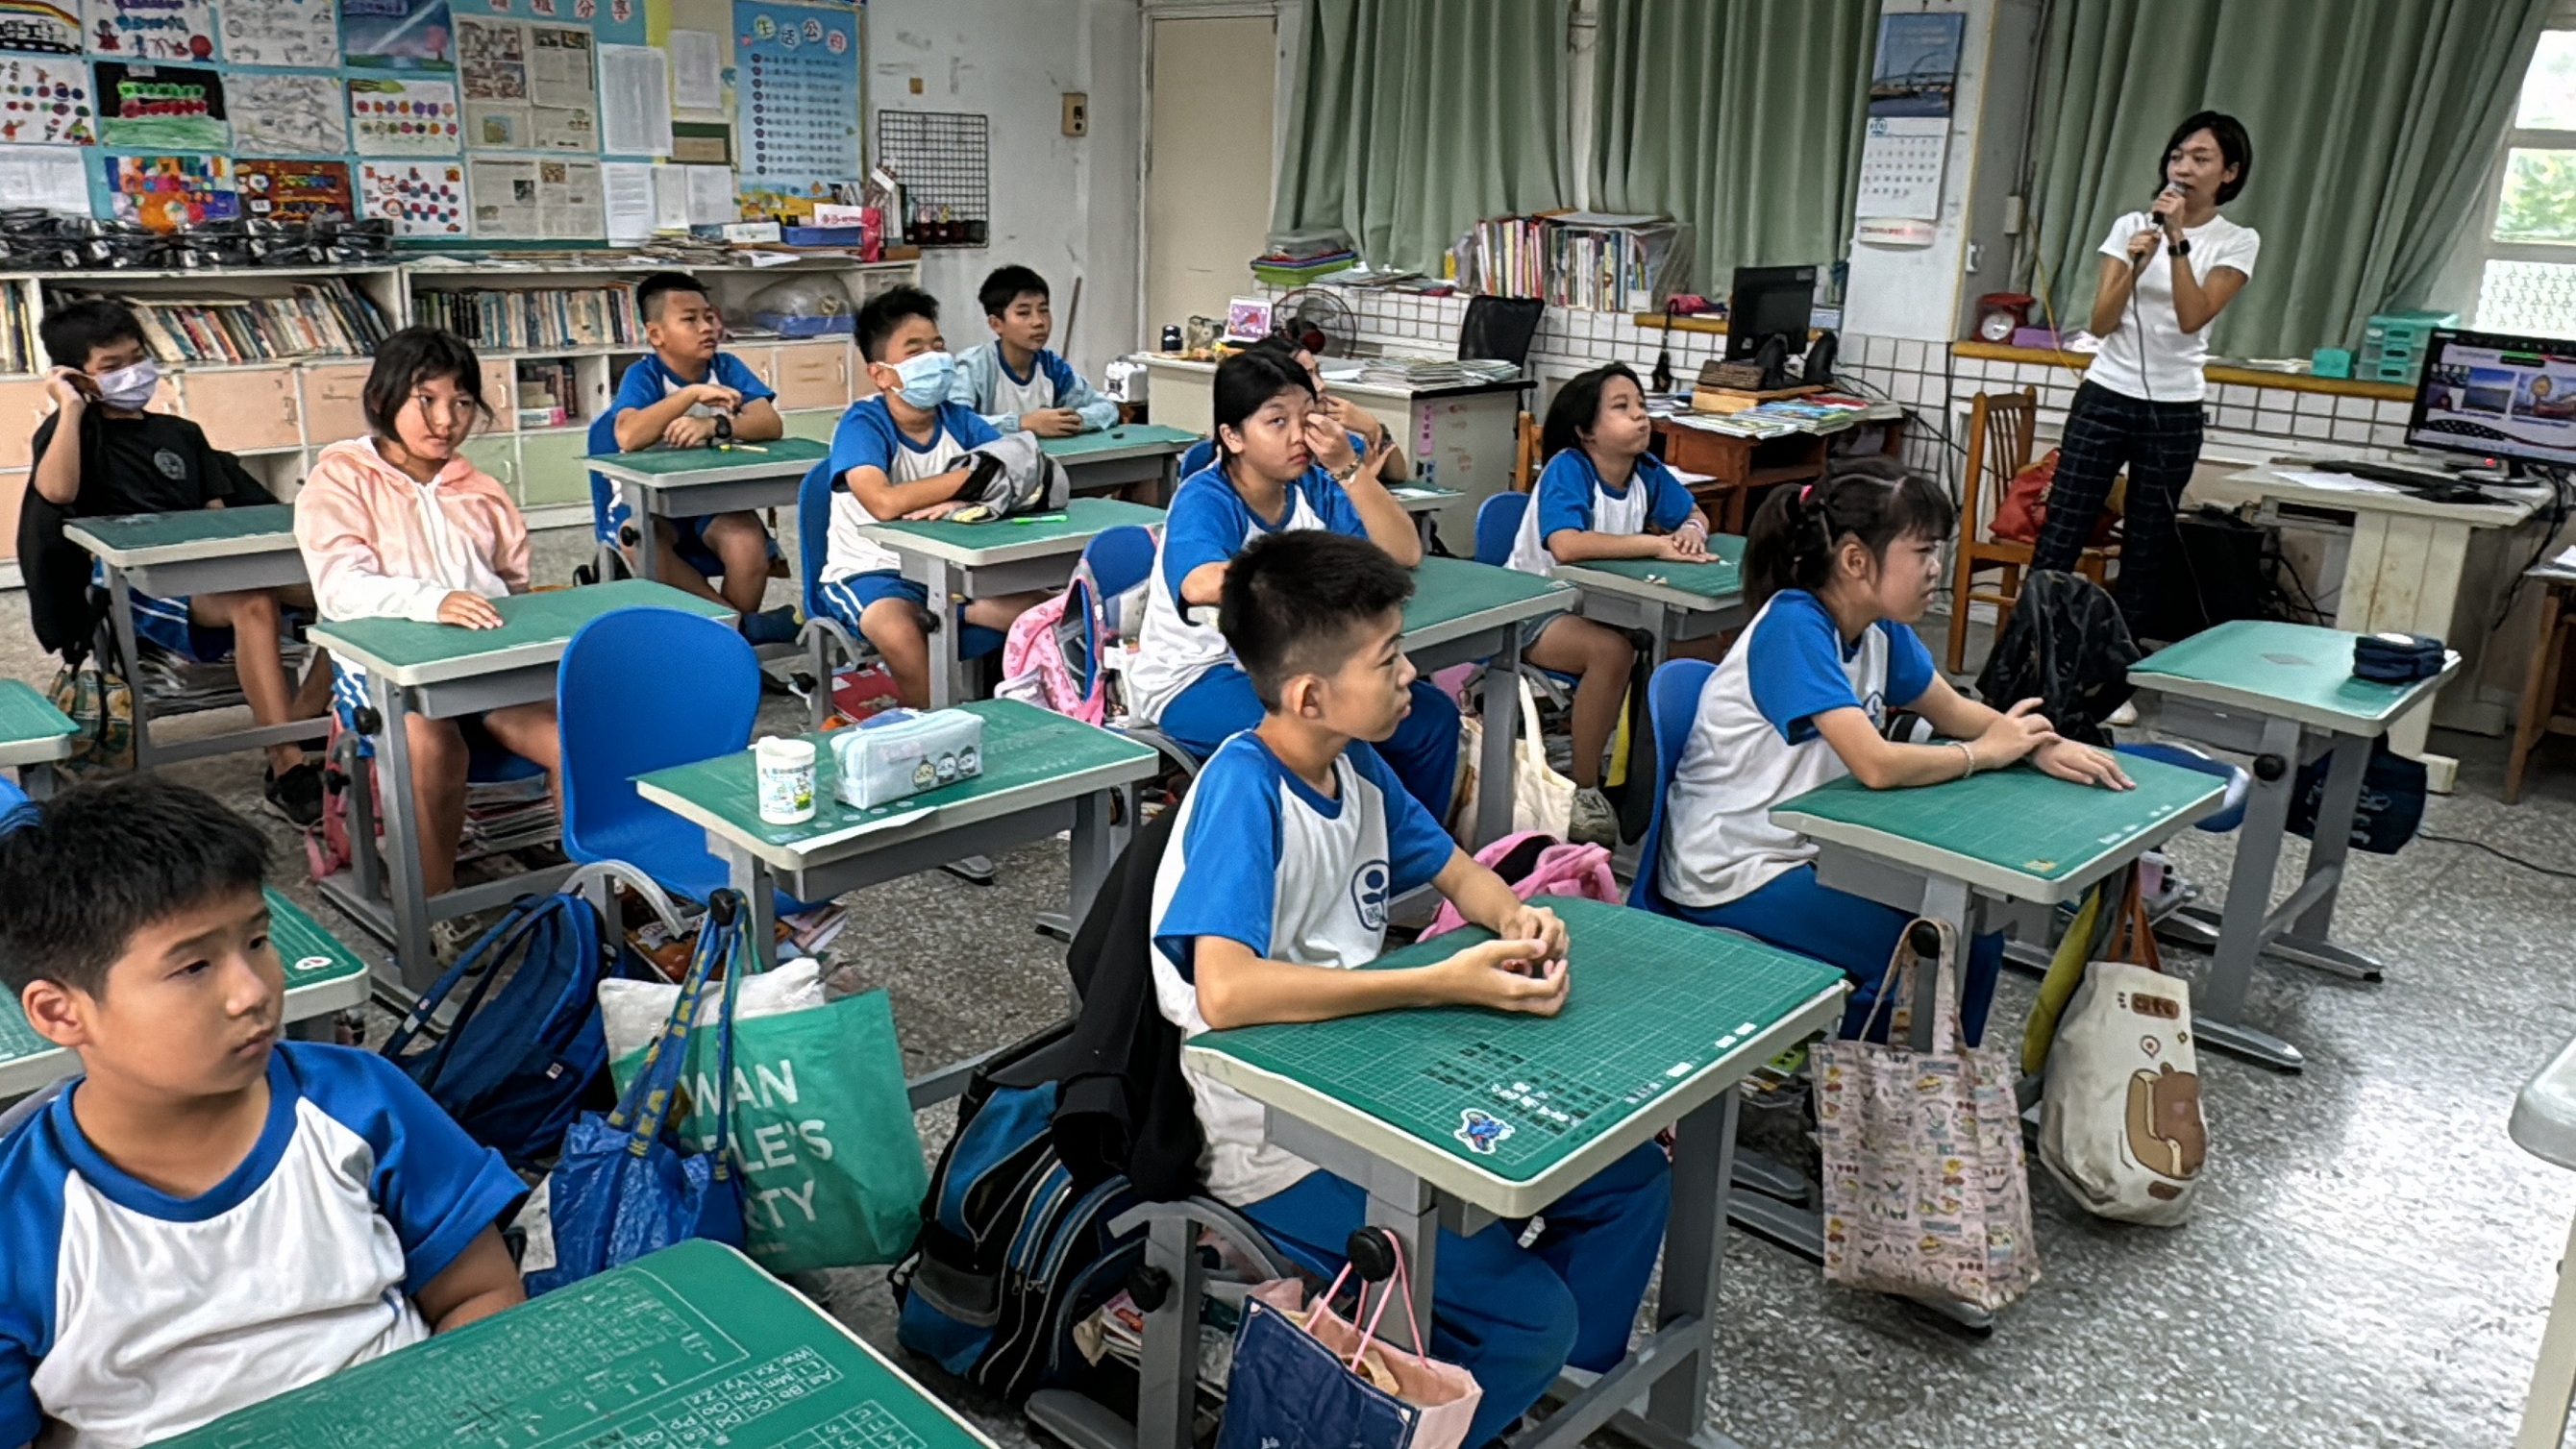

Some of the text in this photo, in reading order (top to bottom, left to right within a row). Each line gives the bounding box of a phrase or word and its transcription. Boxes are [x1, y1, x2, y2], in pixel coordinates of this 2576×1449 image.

[755, 1363, 779, 1377] Xx
[725, 1379, 750, 1391] Yy
[764, 1373, 795, 1388] Mm
[693, 1389, 716, 1404] Zz
[733, 1388, 760, 1401] Nn
[779, 1385, 805, 1398] Bb
[702, 1402, 729, 1415] Oo
[750, 1399, 773, 1412] Cc
[670, 1415, 697, 1430] Pp
[715, 1412, 742, 1429] Dd
[634, 1431, 663, 1445] Qq
